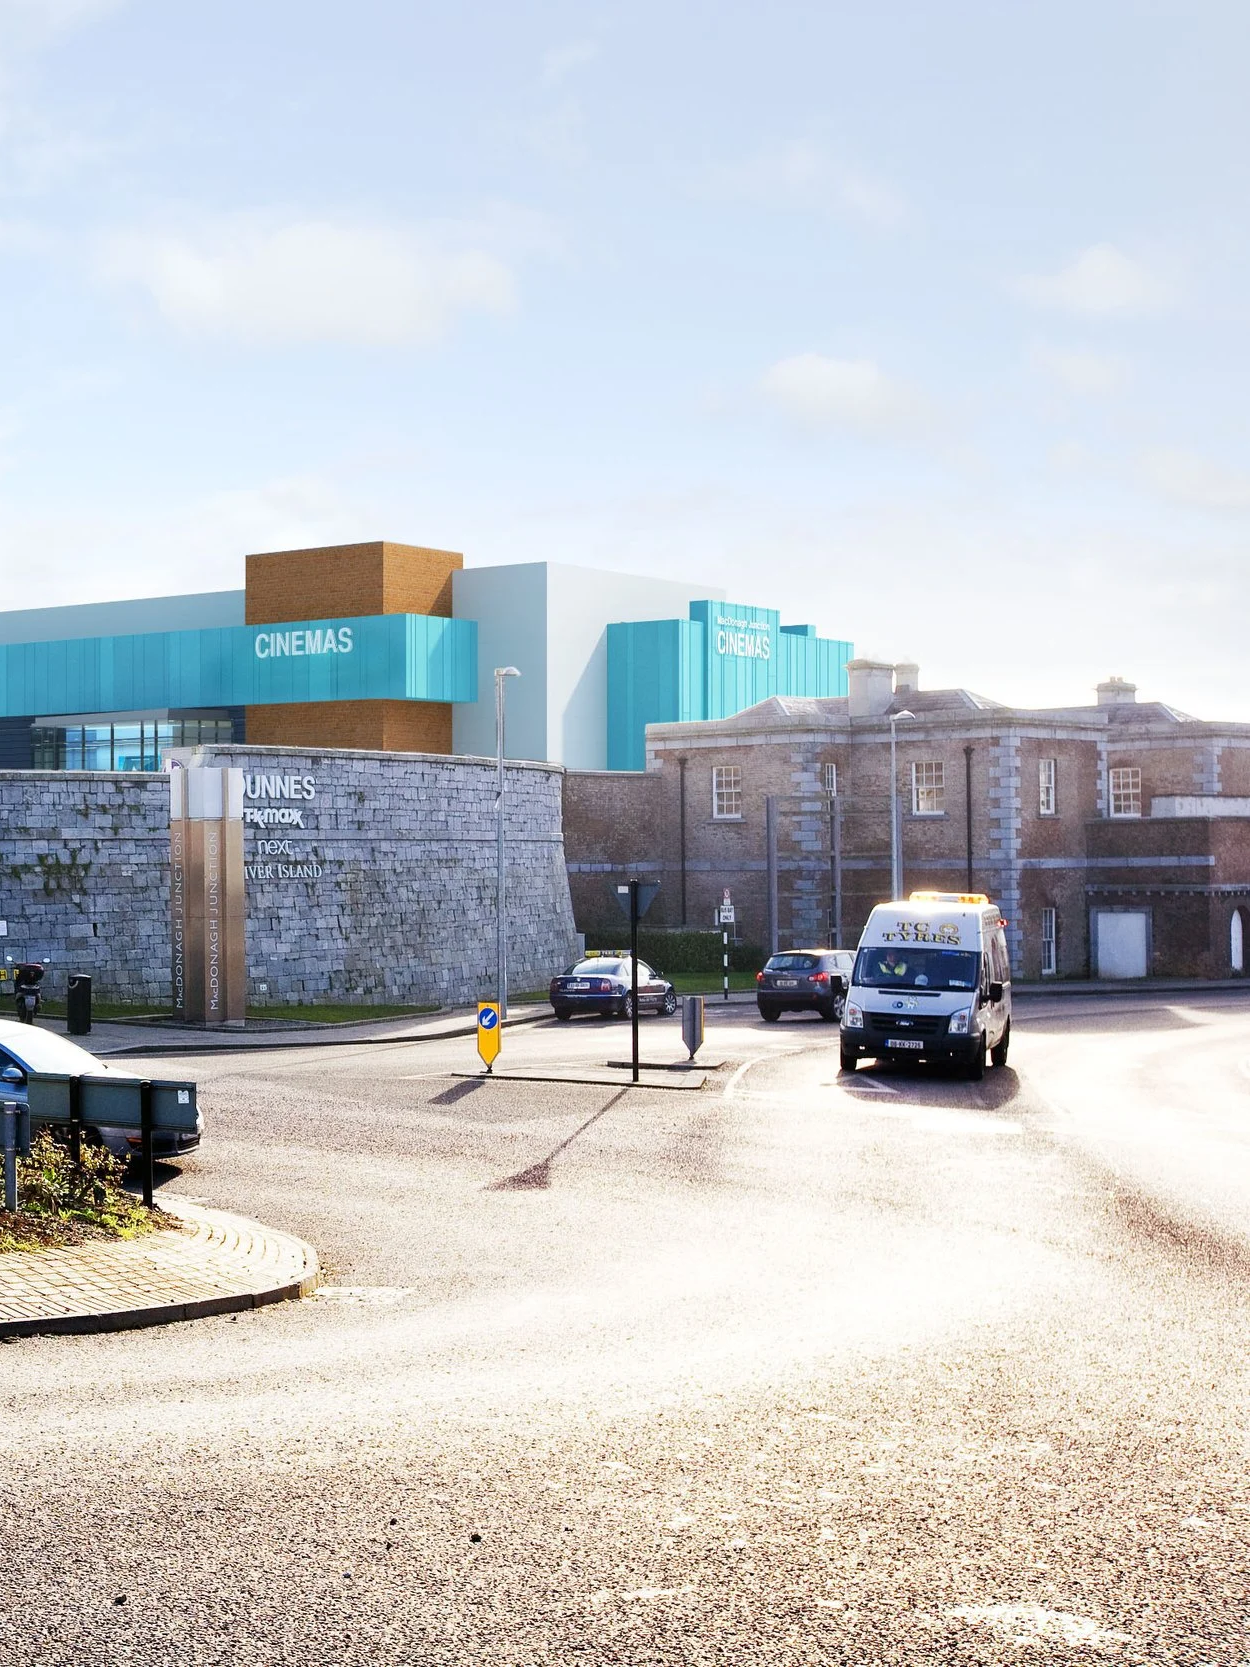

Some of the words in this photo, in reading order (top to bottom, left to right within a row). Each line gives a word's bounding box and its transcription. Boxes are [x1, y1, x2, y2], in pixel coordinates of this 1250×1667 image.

[255, 627, 353, 658] CINEMAS
[717, 630, 770, 660] CINEMAS
[243, 775, 316, 800] UNNES
[257, 840, 294, 854] next
[174, 832, 182, 914] JUNCTION
[209, 833, 218, 914] JUNCTION
[244, 866, 274, 879] IVER
[278, 864, 322, 878] ISLAND
[882, 932, 961, 945] TYRES
[896, 922, 929, 932] TC
